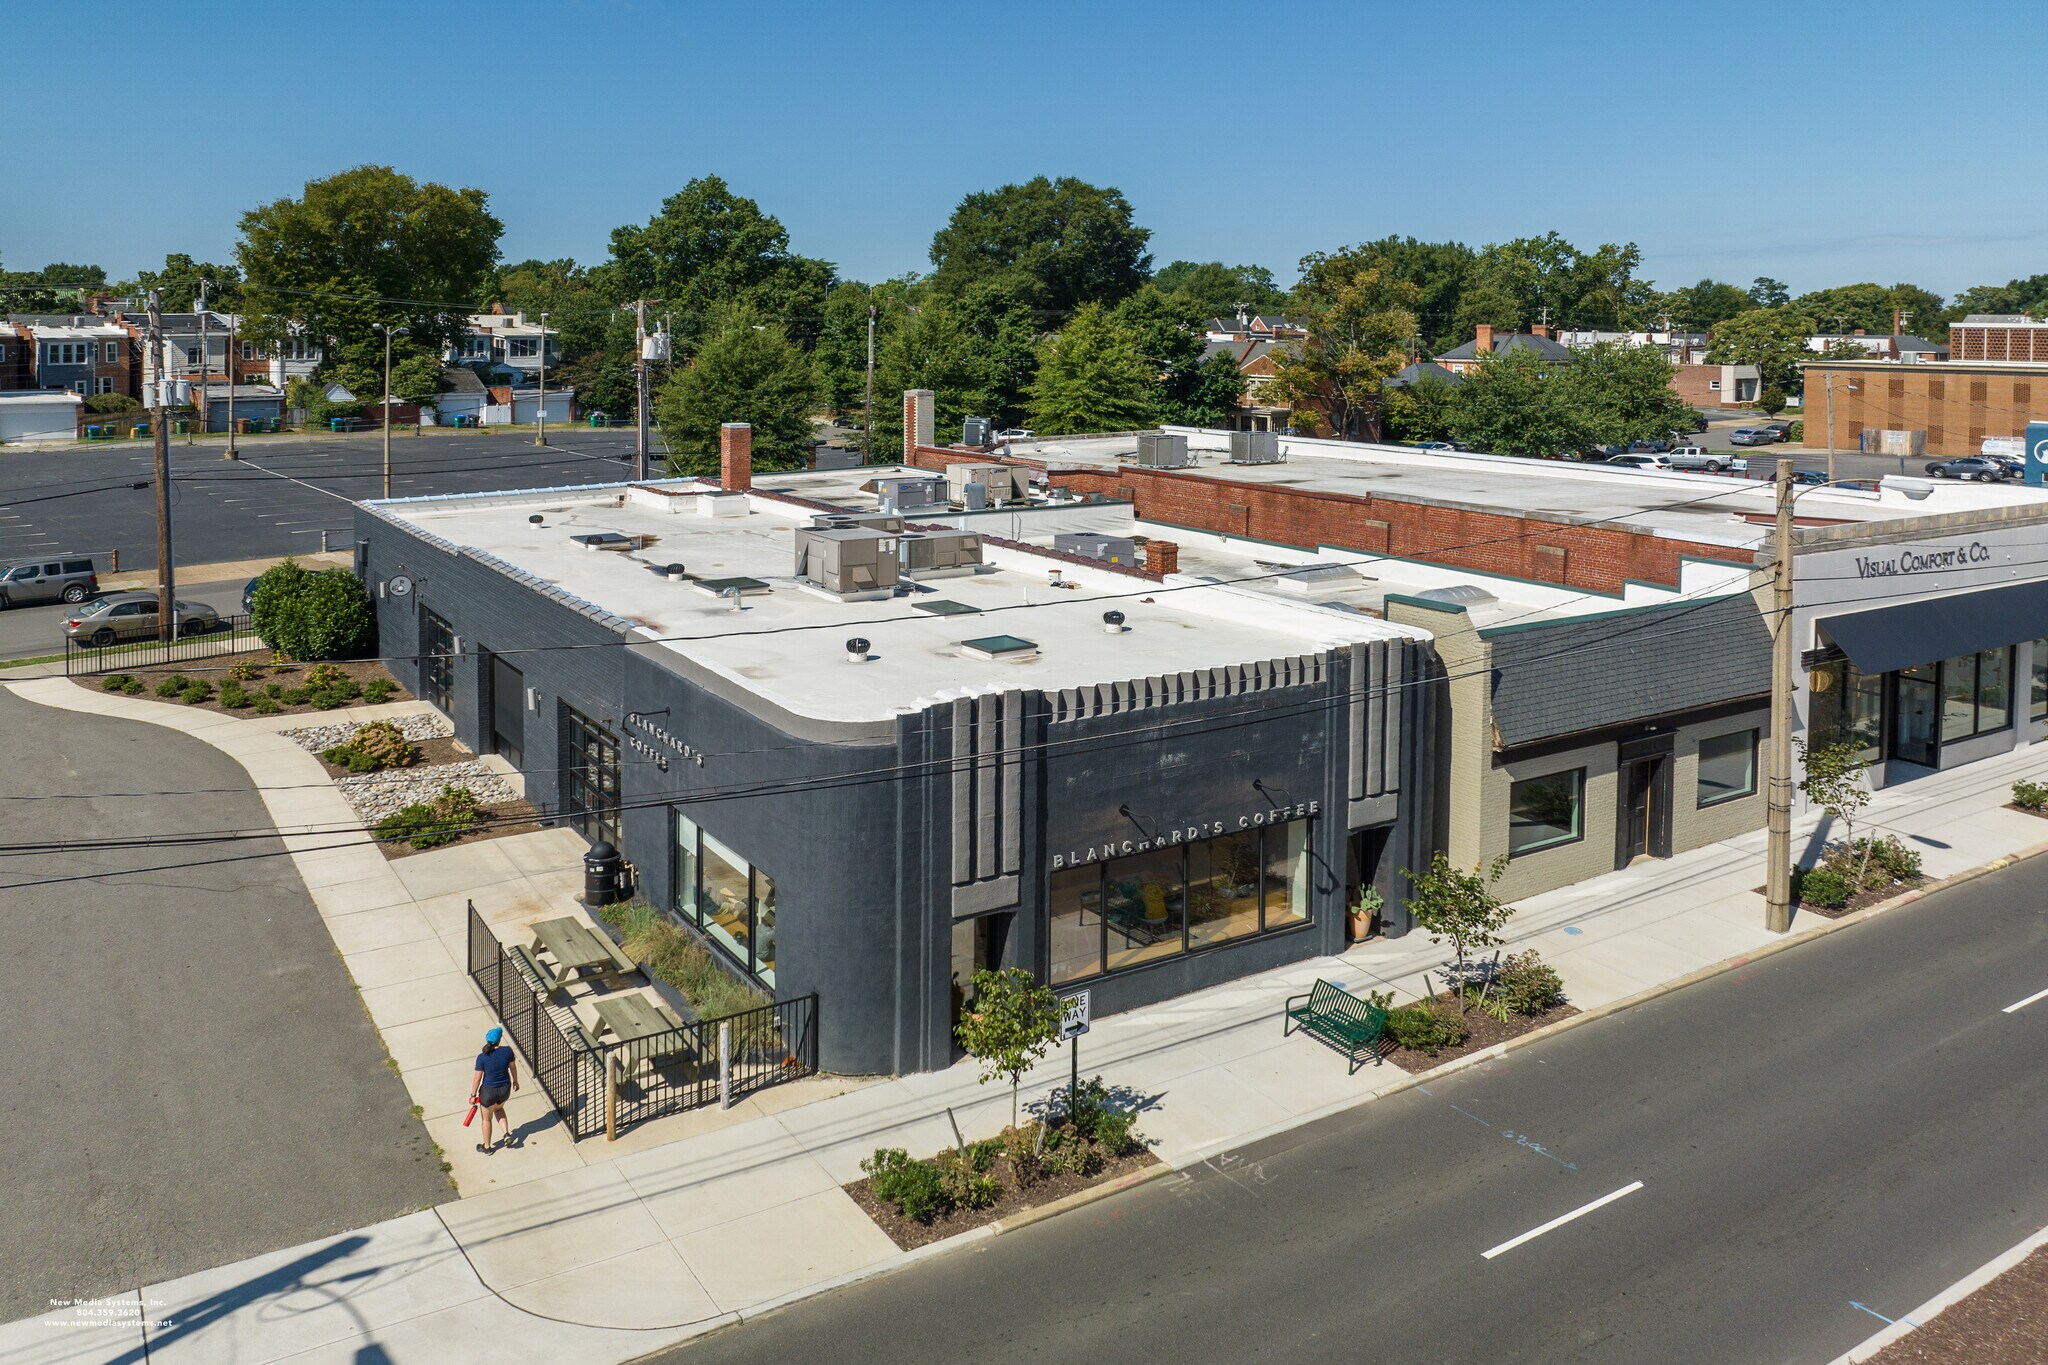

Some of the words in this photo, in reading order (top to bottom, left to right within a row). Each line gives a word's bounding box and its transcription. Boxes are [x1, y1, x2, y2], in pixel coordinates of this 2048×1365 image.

[1957, 547, 1967, 564] &
[630, 713, 702, 765] BLANCHARD'S
[630, 736, 667, 769] COFFEE
[1053, 821, 1223, 868] BLANCHARD'S
[1239, 801, 1318, 828] COFFEE
[1062, 1006, 1086, 1022] WAY
